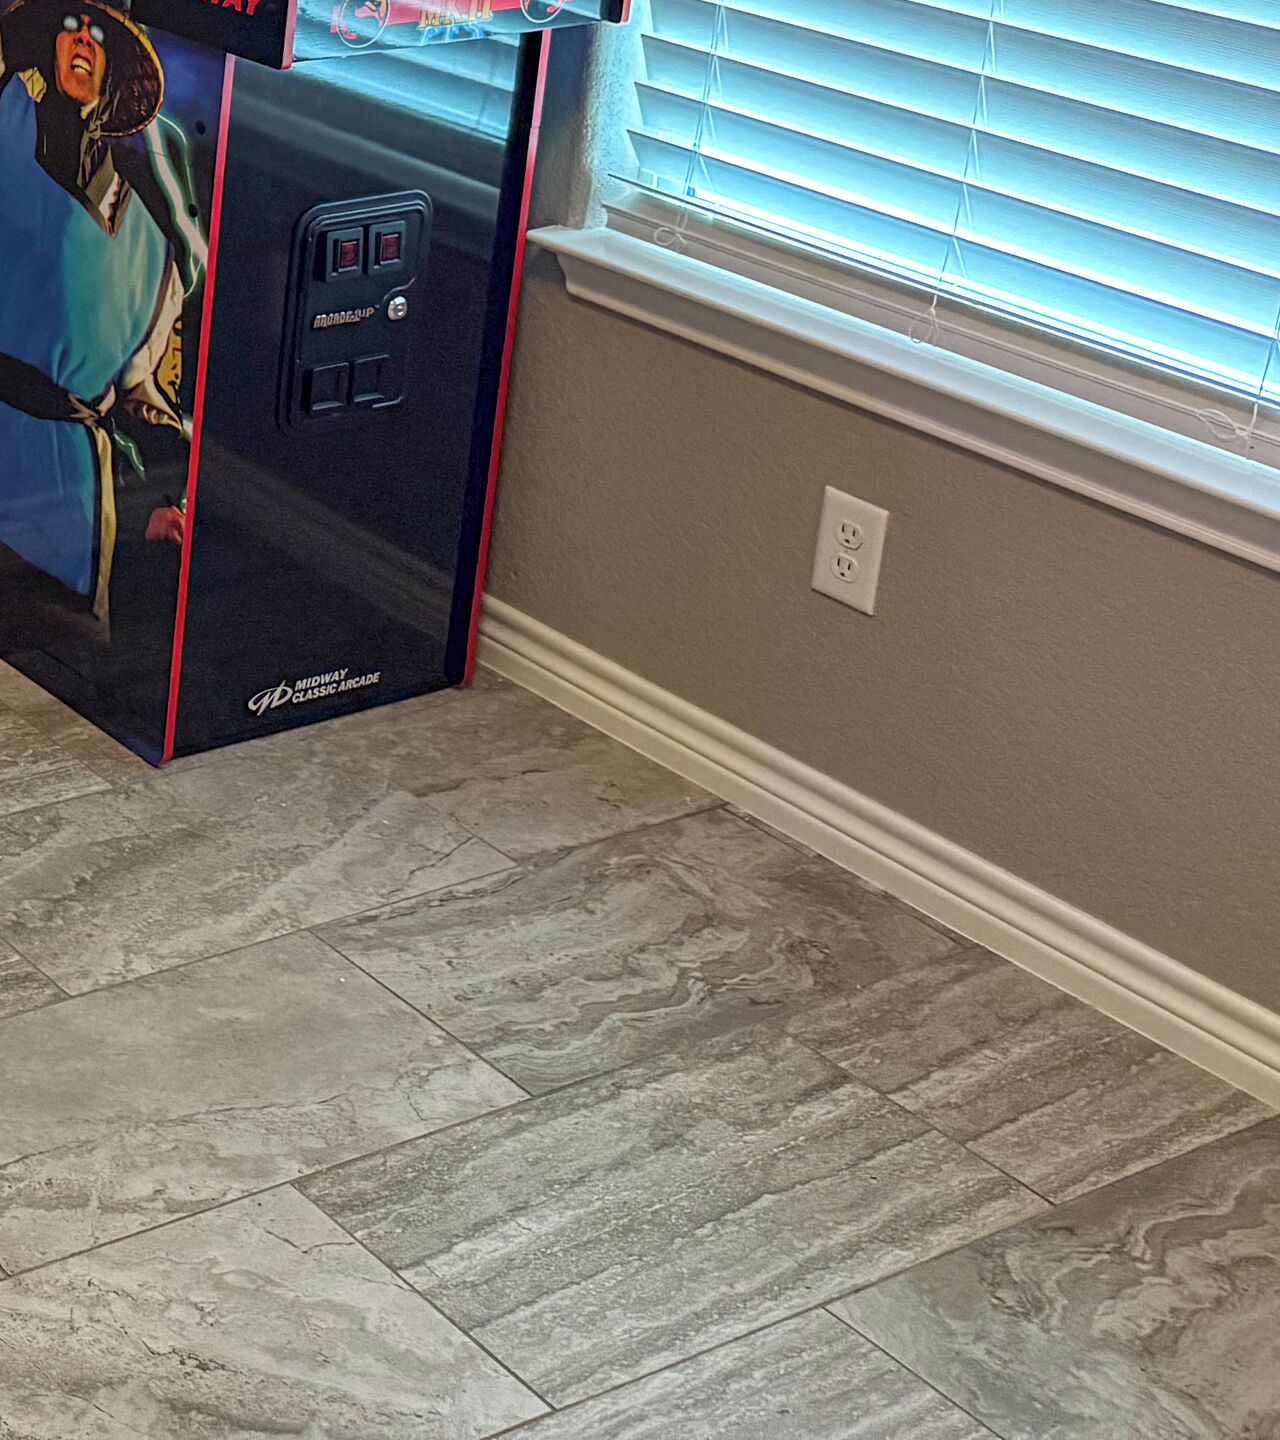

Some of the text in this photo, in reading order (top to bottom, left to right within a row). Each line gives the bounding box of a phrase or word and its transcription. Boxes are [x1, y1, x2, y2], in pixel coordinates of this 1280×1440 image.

[292, 671, 381, 704] CLASSIC ARCADE
[294, 667, 349, 691] MIDWAY
